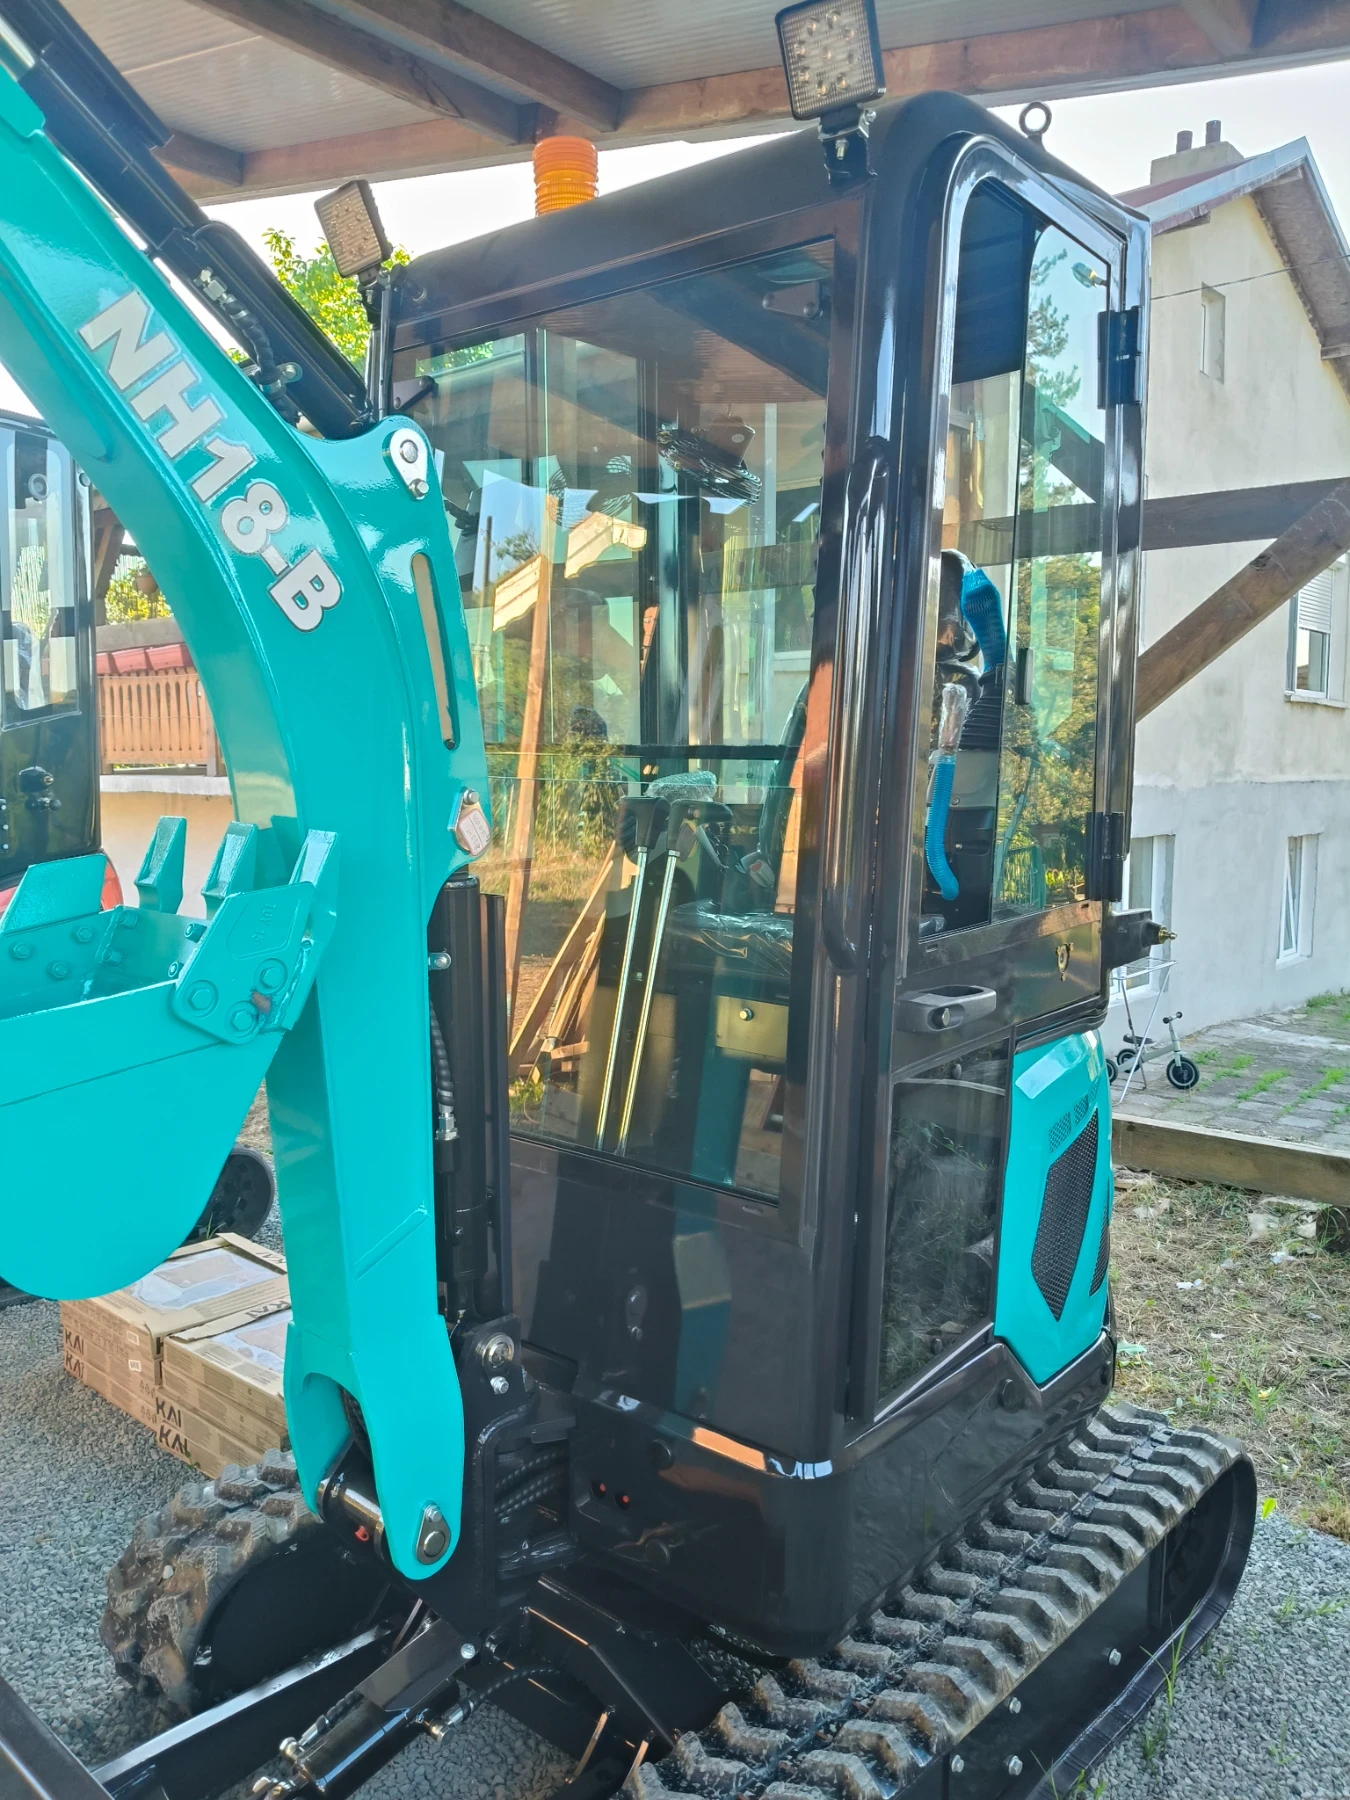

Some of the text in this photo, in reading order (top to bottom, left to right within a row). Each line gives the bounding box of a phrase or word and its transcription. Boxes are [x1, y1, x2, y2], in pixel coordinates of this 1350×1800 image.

[79, 290, 343, 632] NH18-B
[65, 1329, 84, 1355] KAI
[66, 1351, 84, 1379] KAI
[156, 1397, 181, 1427] KAI
